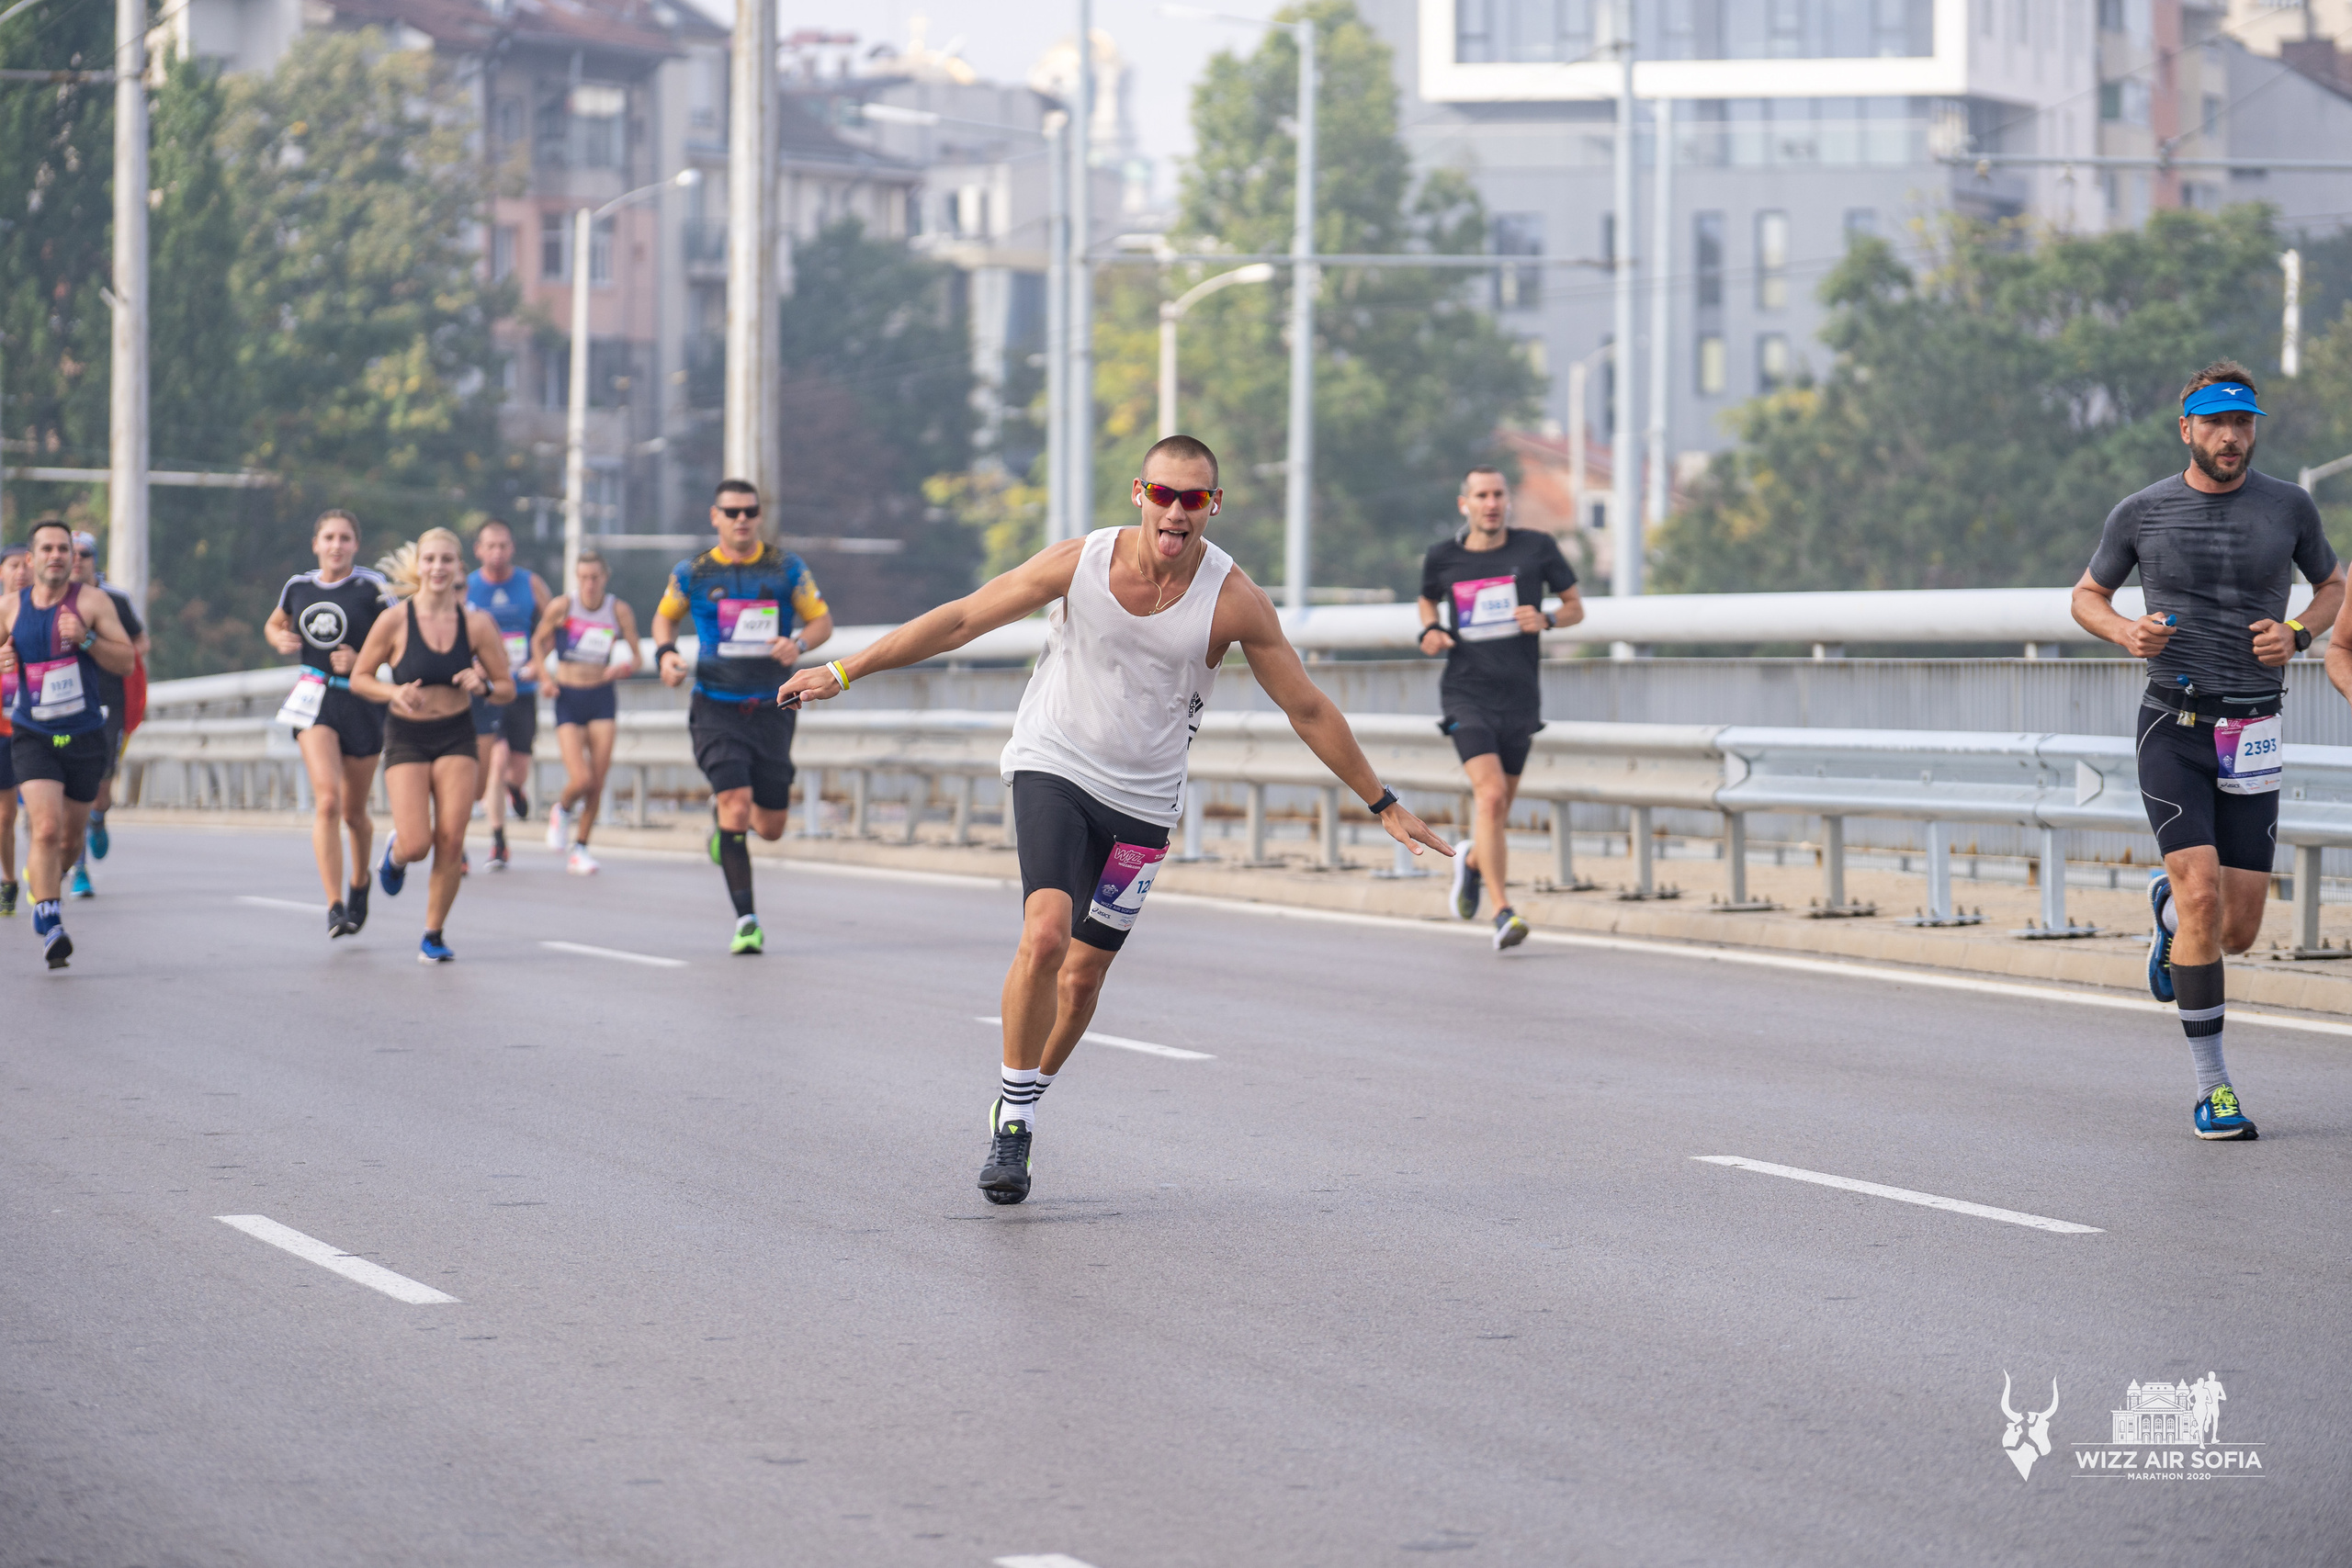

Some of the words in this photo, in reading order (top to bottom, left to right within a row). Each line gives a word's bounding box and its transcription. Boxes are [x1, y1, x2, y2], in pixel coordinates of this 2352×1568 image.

[1188, 691, 1197, 718] adidas
[2245, 738, 2277, 756] 2393
[1097, 910, 1111, 919] asics
